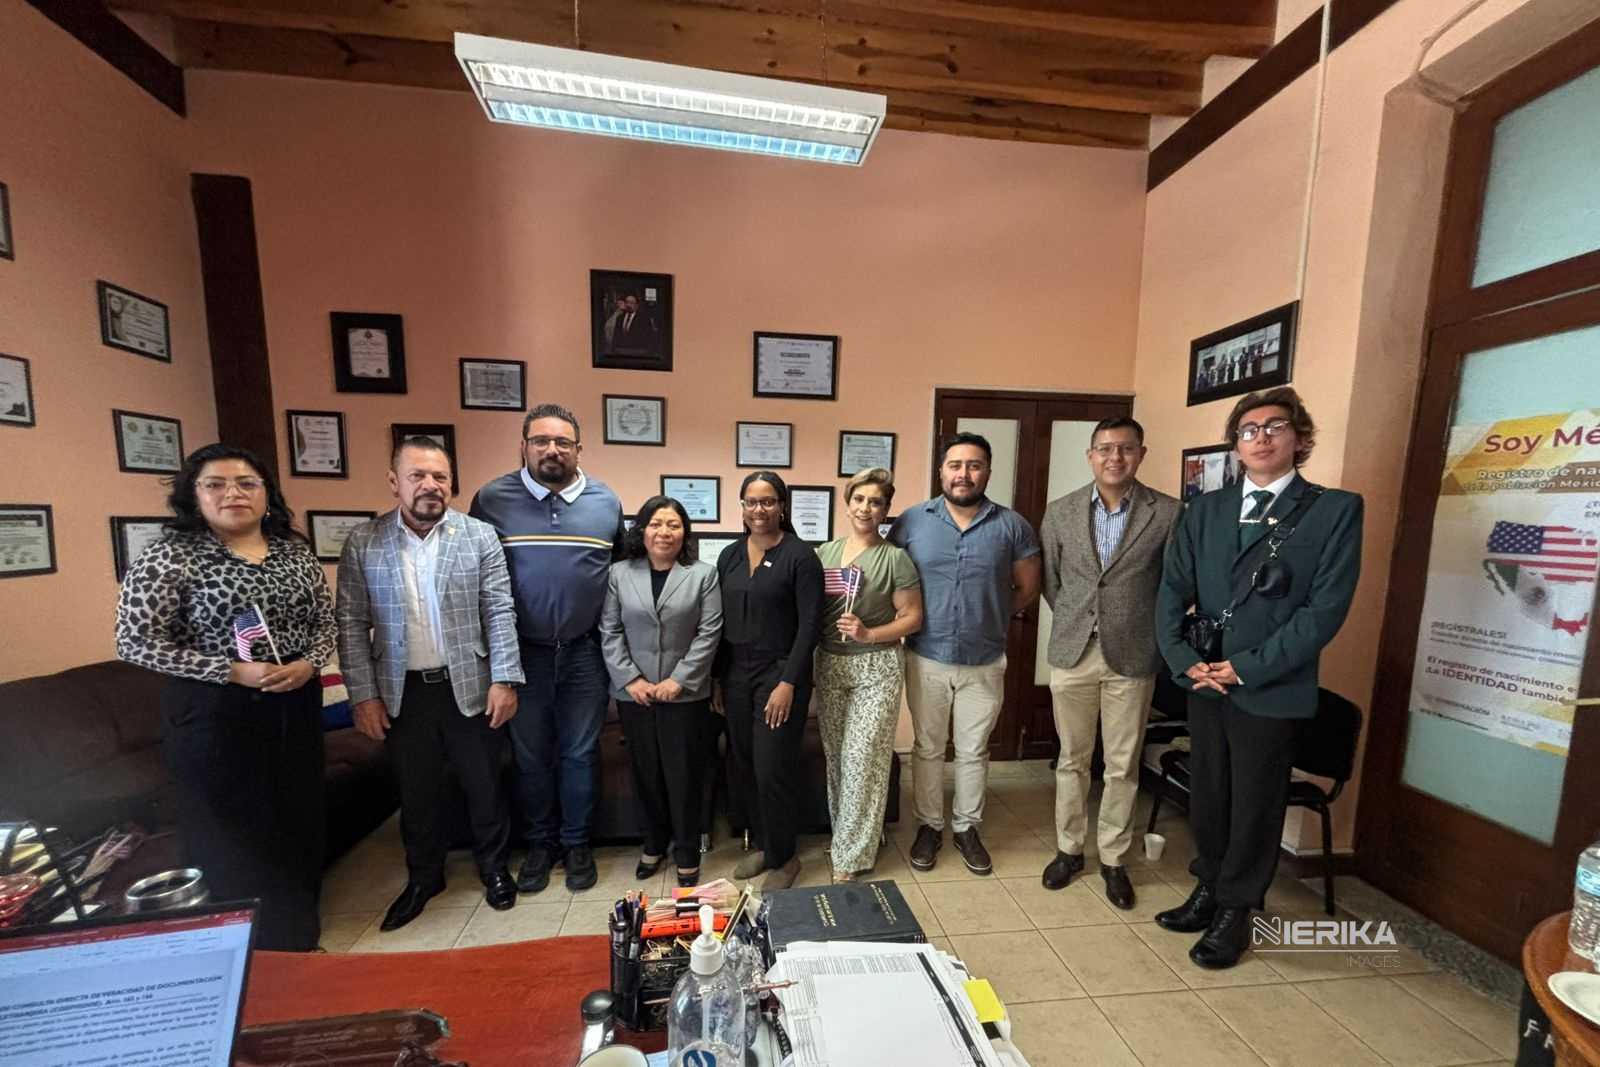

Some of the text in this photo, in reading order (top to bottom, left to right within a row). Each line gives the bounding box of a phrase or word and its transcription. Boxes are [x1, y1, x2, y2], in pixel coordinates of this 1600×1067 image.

[1483, 433, 1543, 455] Soy
[1478, 468, 1545, 481] Registro
[1548, 465, 1570, 477] de
[1427, 655, 1436, 664] El
[1438, 658, 1478, 673] registro
[1479, 666, 1494, 676] de
[1495, 671, 1565, 691] nacimiento
[1442, 668, 1519, 693] IDENTIDAD
